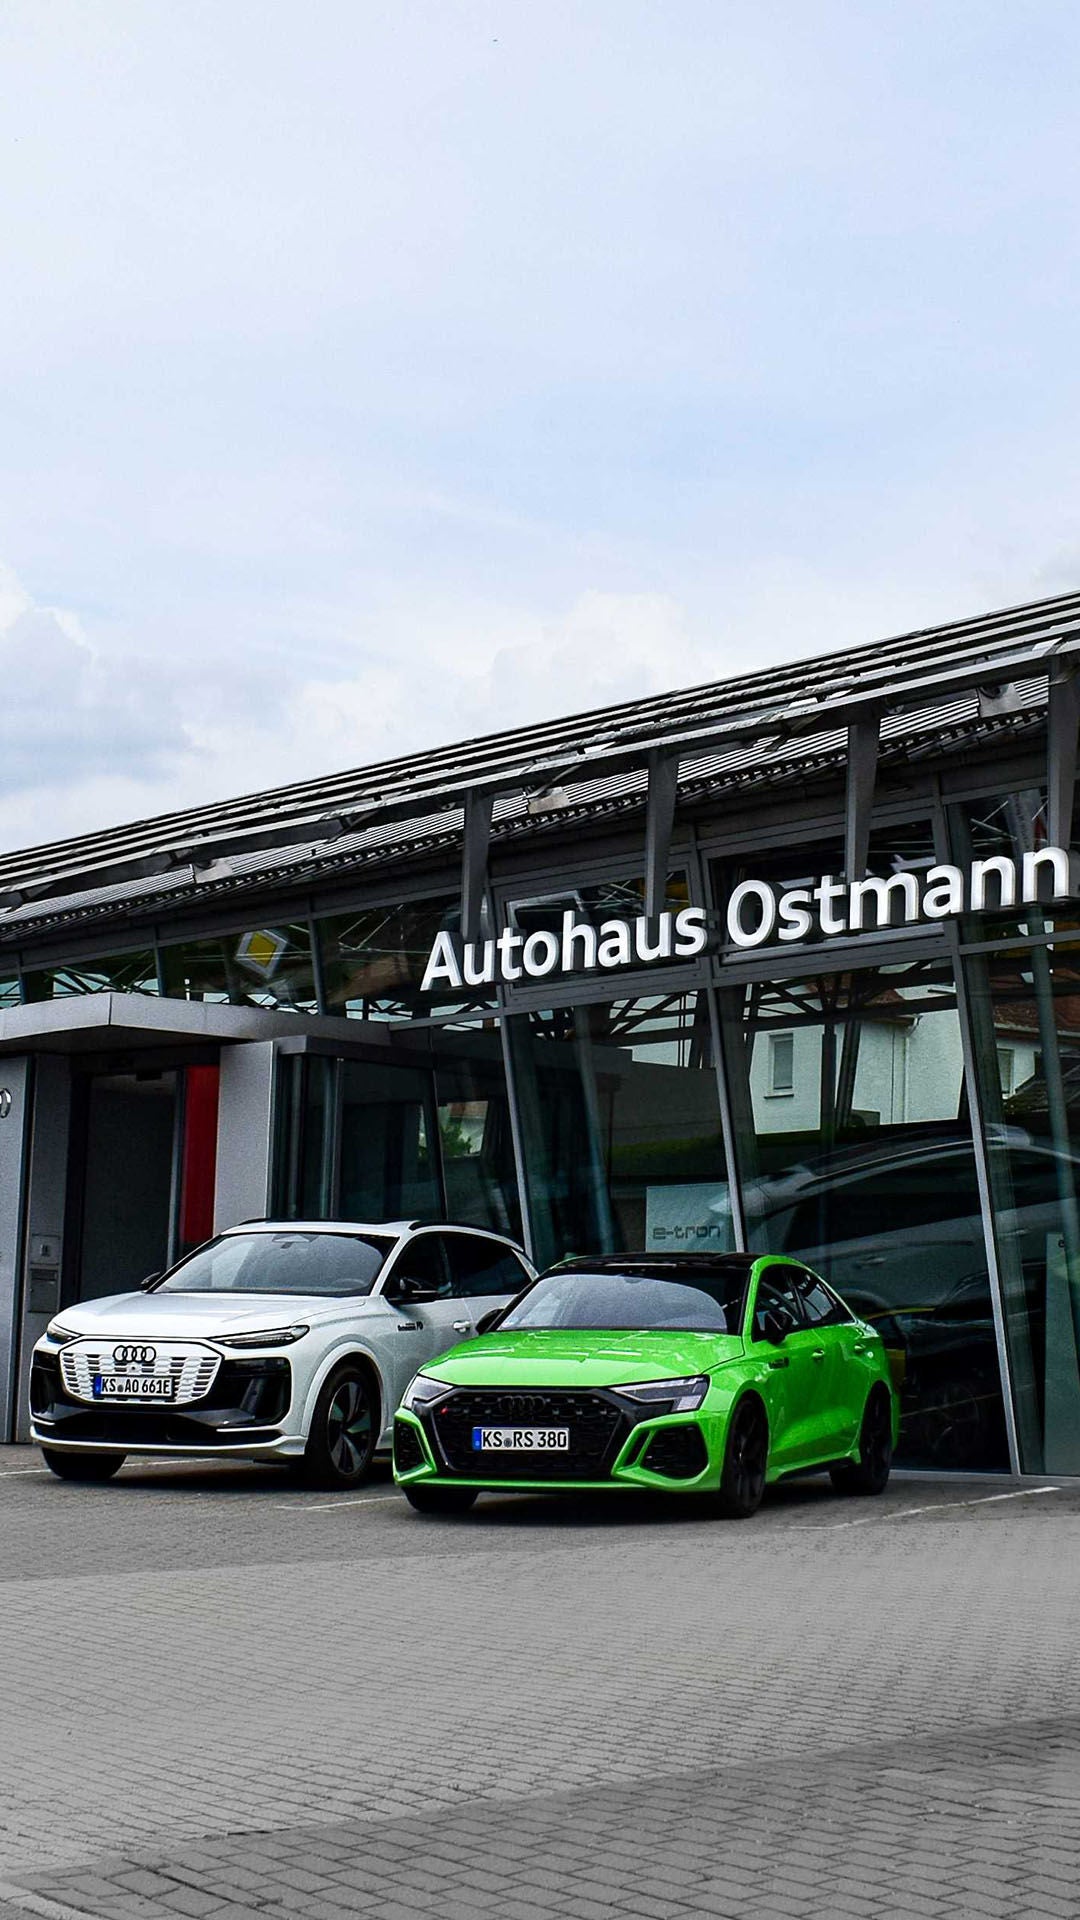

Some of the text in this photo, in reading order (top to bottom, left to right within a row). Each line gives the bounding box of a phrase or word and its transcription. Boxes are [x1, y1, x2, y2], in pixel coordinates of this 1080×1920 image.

[420, 846, 1070, 991] Autohaus Ostmann
[652, 1225, 721, 1240] e-tron
[101, 1378, 116, 1393] KS
[142, 1379, 171, 1395] 661E
[482, 1431, 567, 1448] KS RS 380
